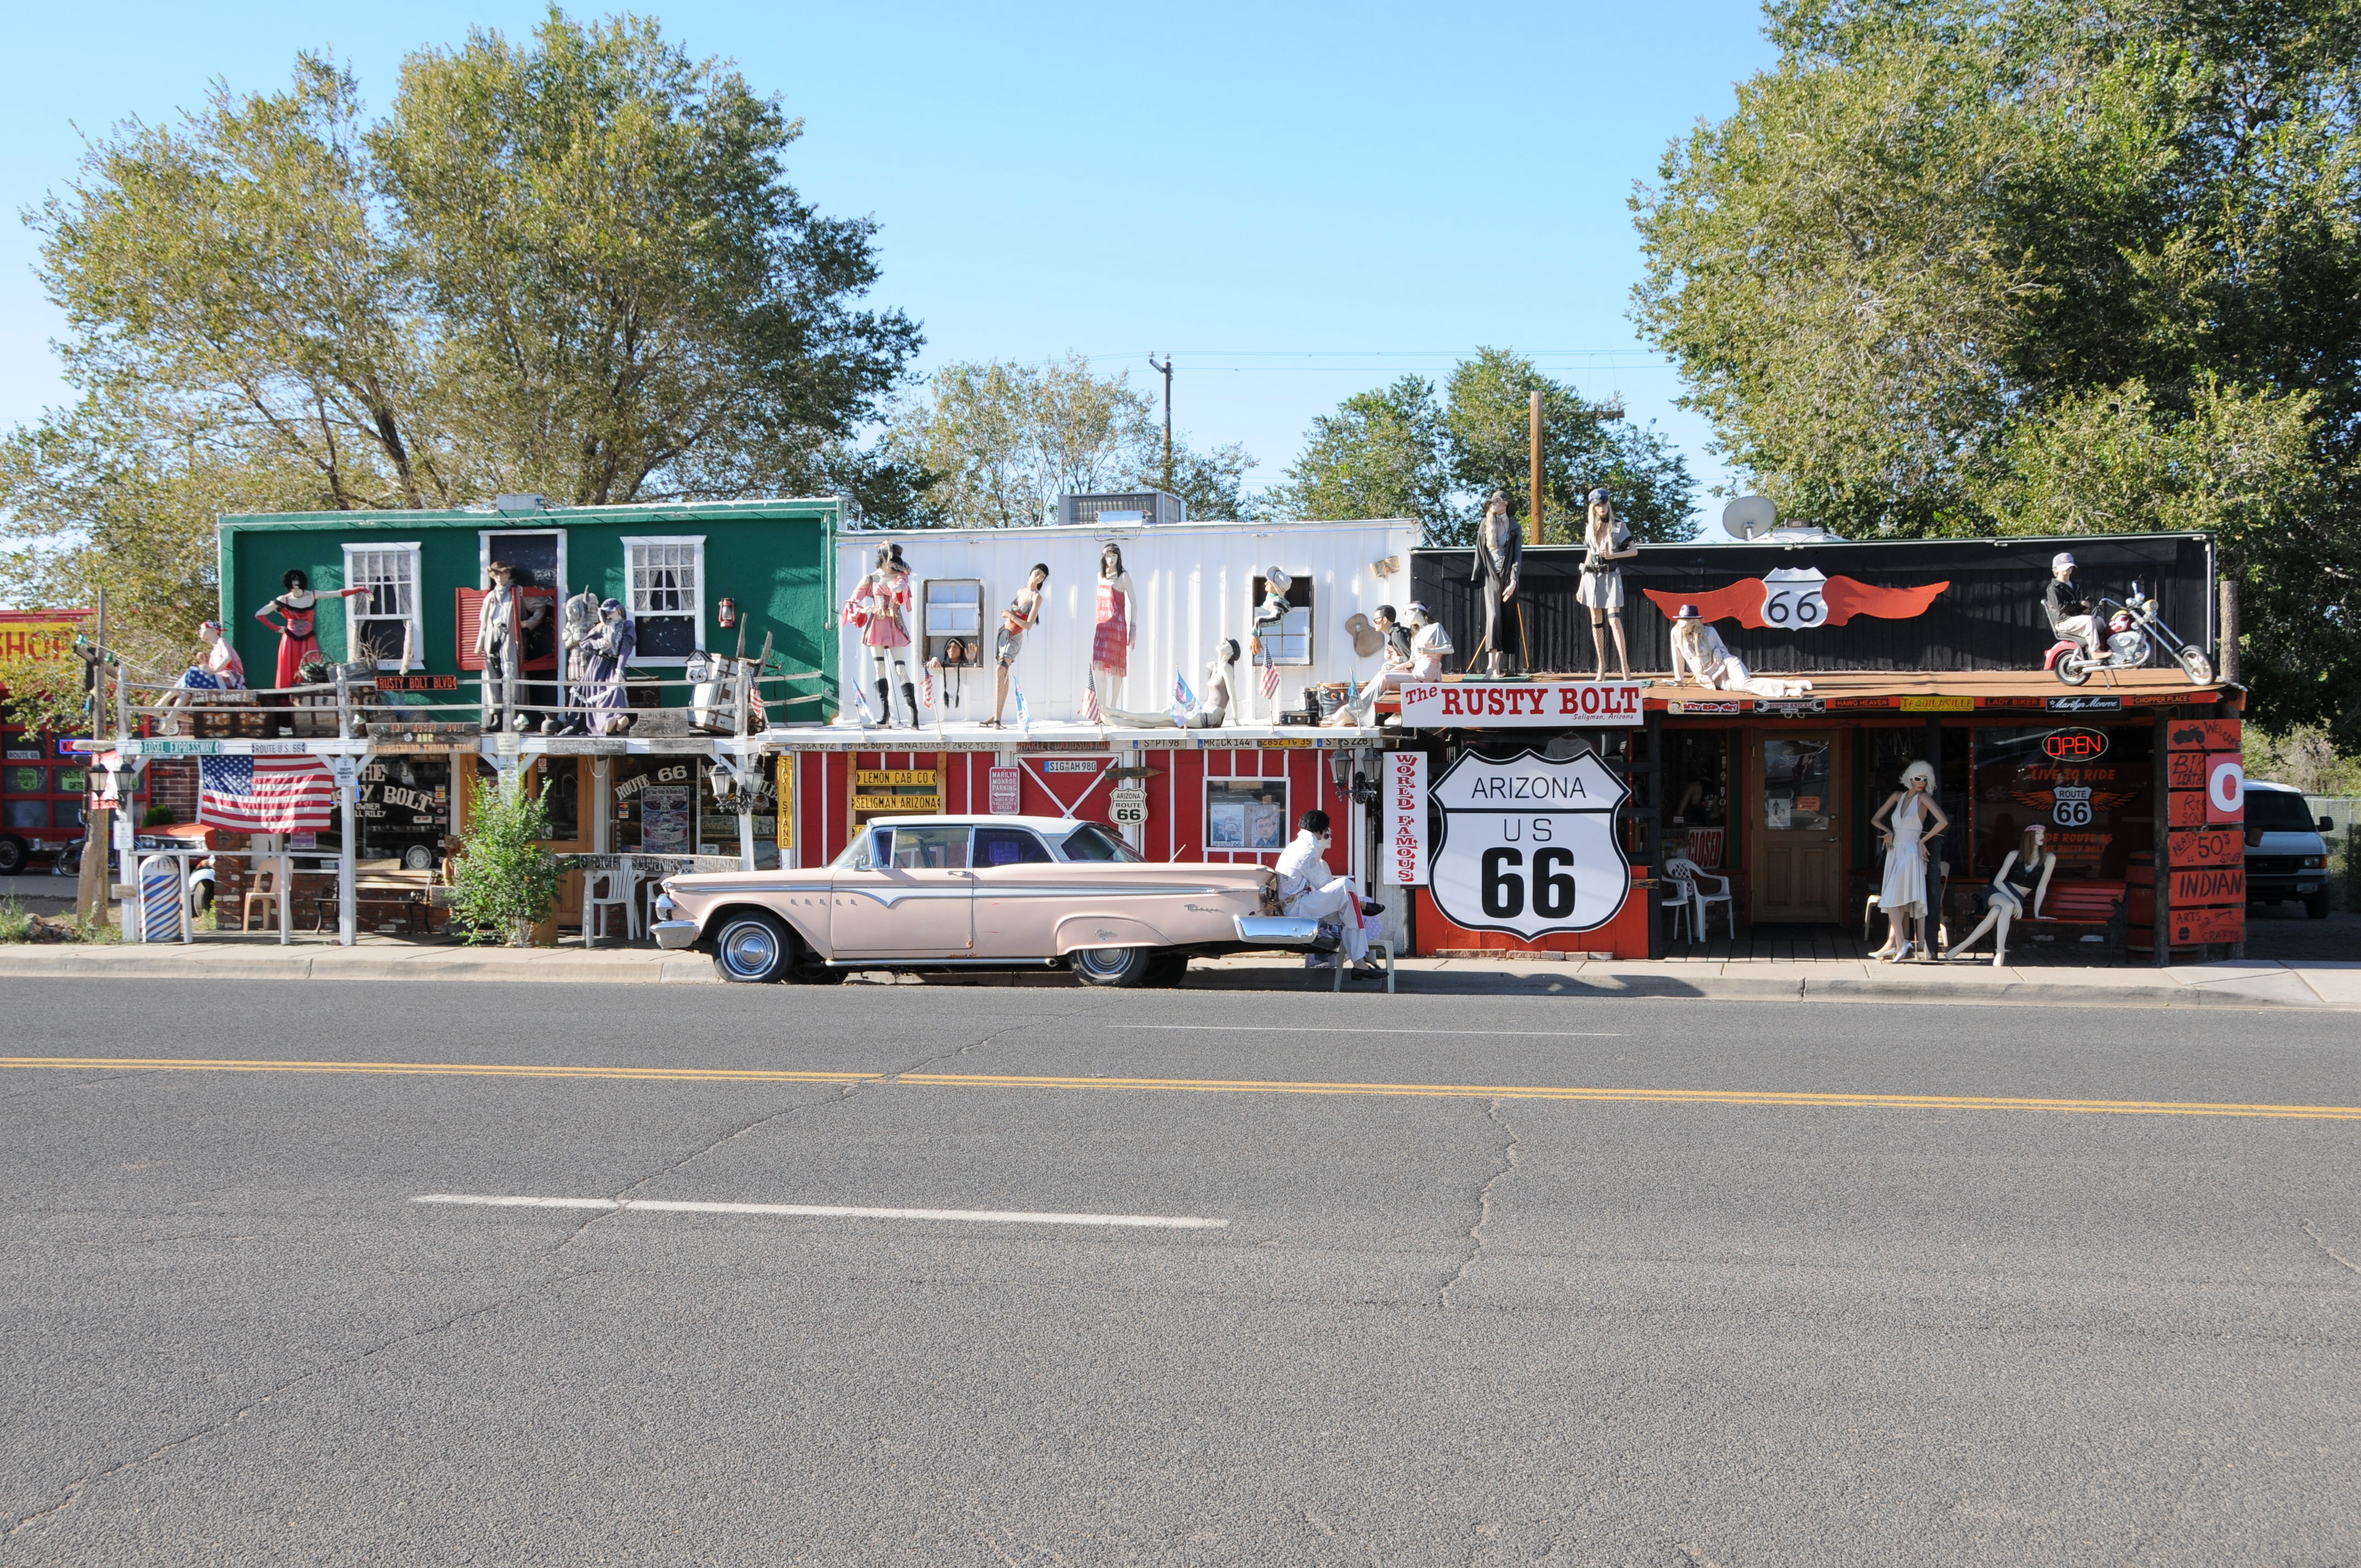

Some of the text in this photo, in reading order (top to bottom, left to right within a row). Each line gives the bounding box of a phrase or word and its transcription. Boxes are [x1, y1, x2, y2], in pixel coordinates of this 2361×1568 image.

[1768, 591, 1820, 623] 66
[0, 631, 72, 662] HOP
[379, 677, 452, 688] RUSTY BOLT BLVD
[1405, 686, 1640, 715] The RUSTY BOLT
[1902, 698, 1972, 708] TEQUILAVILLE
[2053, 698, 2117, 710] Marilyn Monroe
[412, 723, 437, 732] RUSTY
[447, 723, 465, 732] BOLT
[144, 742, 213, 753] EDSEL EXPRESSWAY
[255, 743, 302, 753] ROUTE U.S. 66
[424, 744, 449, 752] INDIAN
[454, 744, 475, 752] STORE
[1054, 742, 1092, 750] DAVIDSON
[2047, 734, 2101, 755] OPEN
[1049, 762, 1096, 771] SIG AH 980
[362, 764, 385, 782] HE
[863, 772, 928, 783] LEMON CAB CO
[2031, 769, 2059, 780] LIVE
[2083, 769, 2116, 780] RIDE
[614, 765, 688, 801] ROUTE 66
[1395, 755, 1418, 810] WORLD
[1471, 776, 1587, 799] ARIZONA
[382, 785, 434, 813] BOLT
[1117, 809, 1141, 820] 66
[2057, 802, 2088, 823] 66
[2062, 833, 2096, 843] ROUTE
[2098, 834, 2113, 843] 66
[1395, 815, 1418, 882] FAMOUS
[1688, 831, 1722, 867] CLOSED
[632, 856, 683, 873] SOUVENIRS
[695, 858, 736, 868] INDIAN
[1482, 846, 1576, 919] 66
[2179, 872, 2243, 898] INDIAN
[2176, 912, 2201, 924] ARTS
[2202, 930, 2240, 941] CRAFTS
